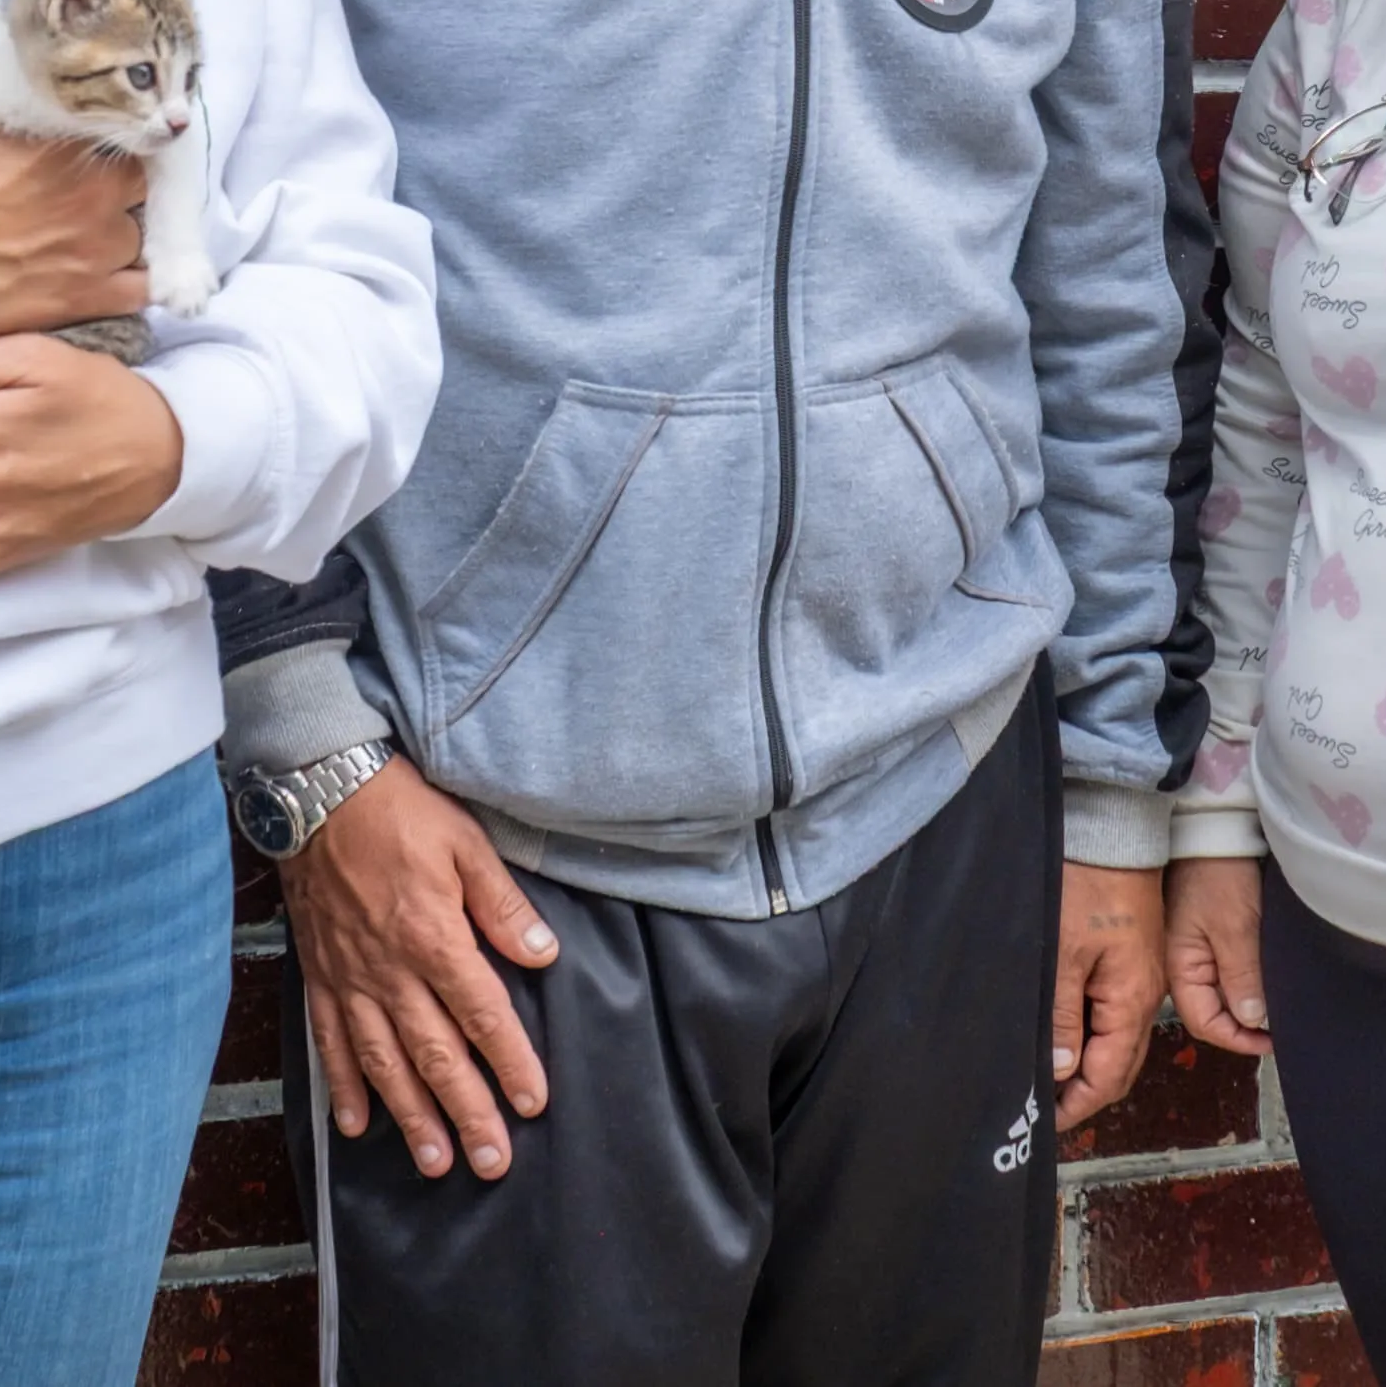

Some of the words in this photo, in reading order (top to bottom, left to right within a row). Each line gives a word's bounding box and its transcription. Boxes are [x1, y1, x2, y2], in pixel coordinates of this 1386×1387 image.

[1256, 124, 1300, 165] Swe
[1301, 254, 1340, 288] Girl
[1301, 290, 1367, 330] Sweet
[1287, 686, 1323, 721] Girl
[1290, 716, 1357, 769] Sweet
